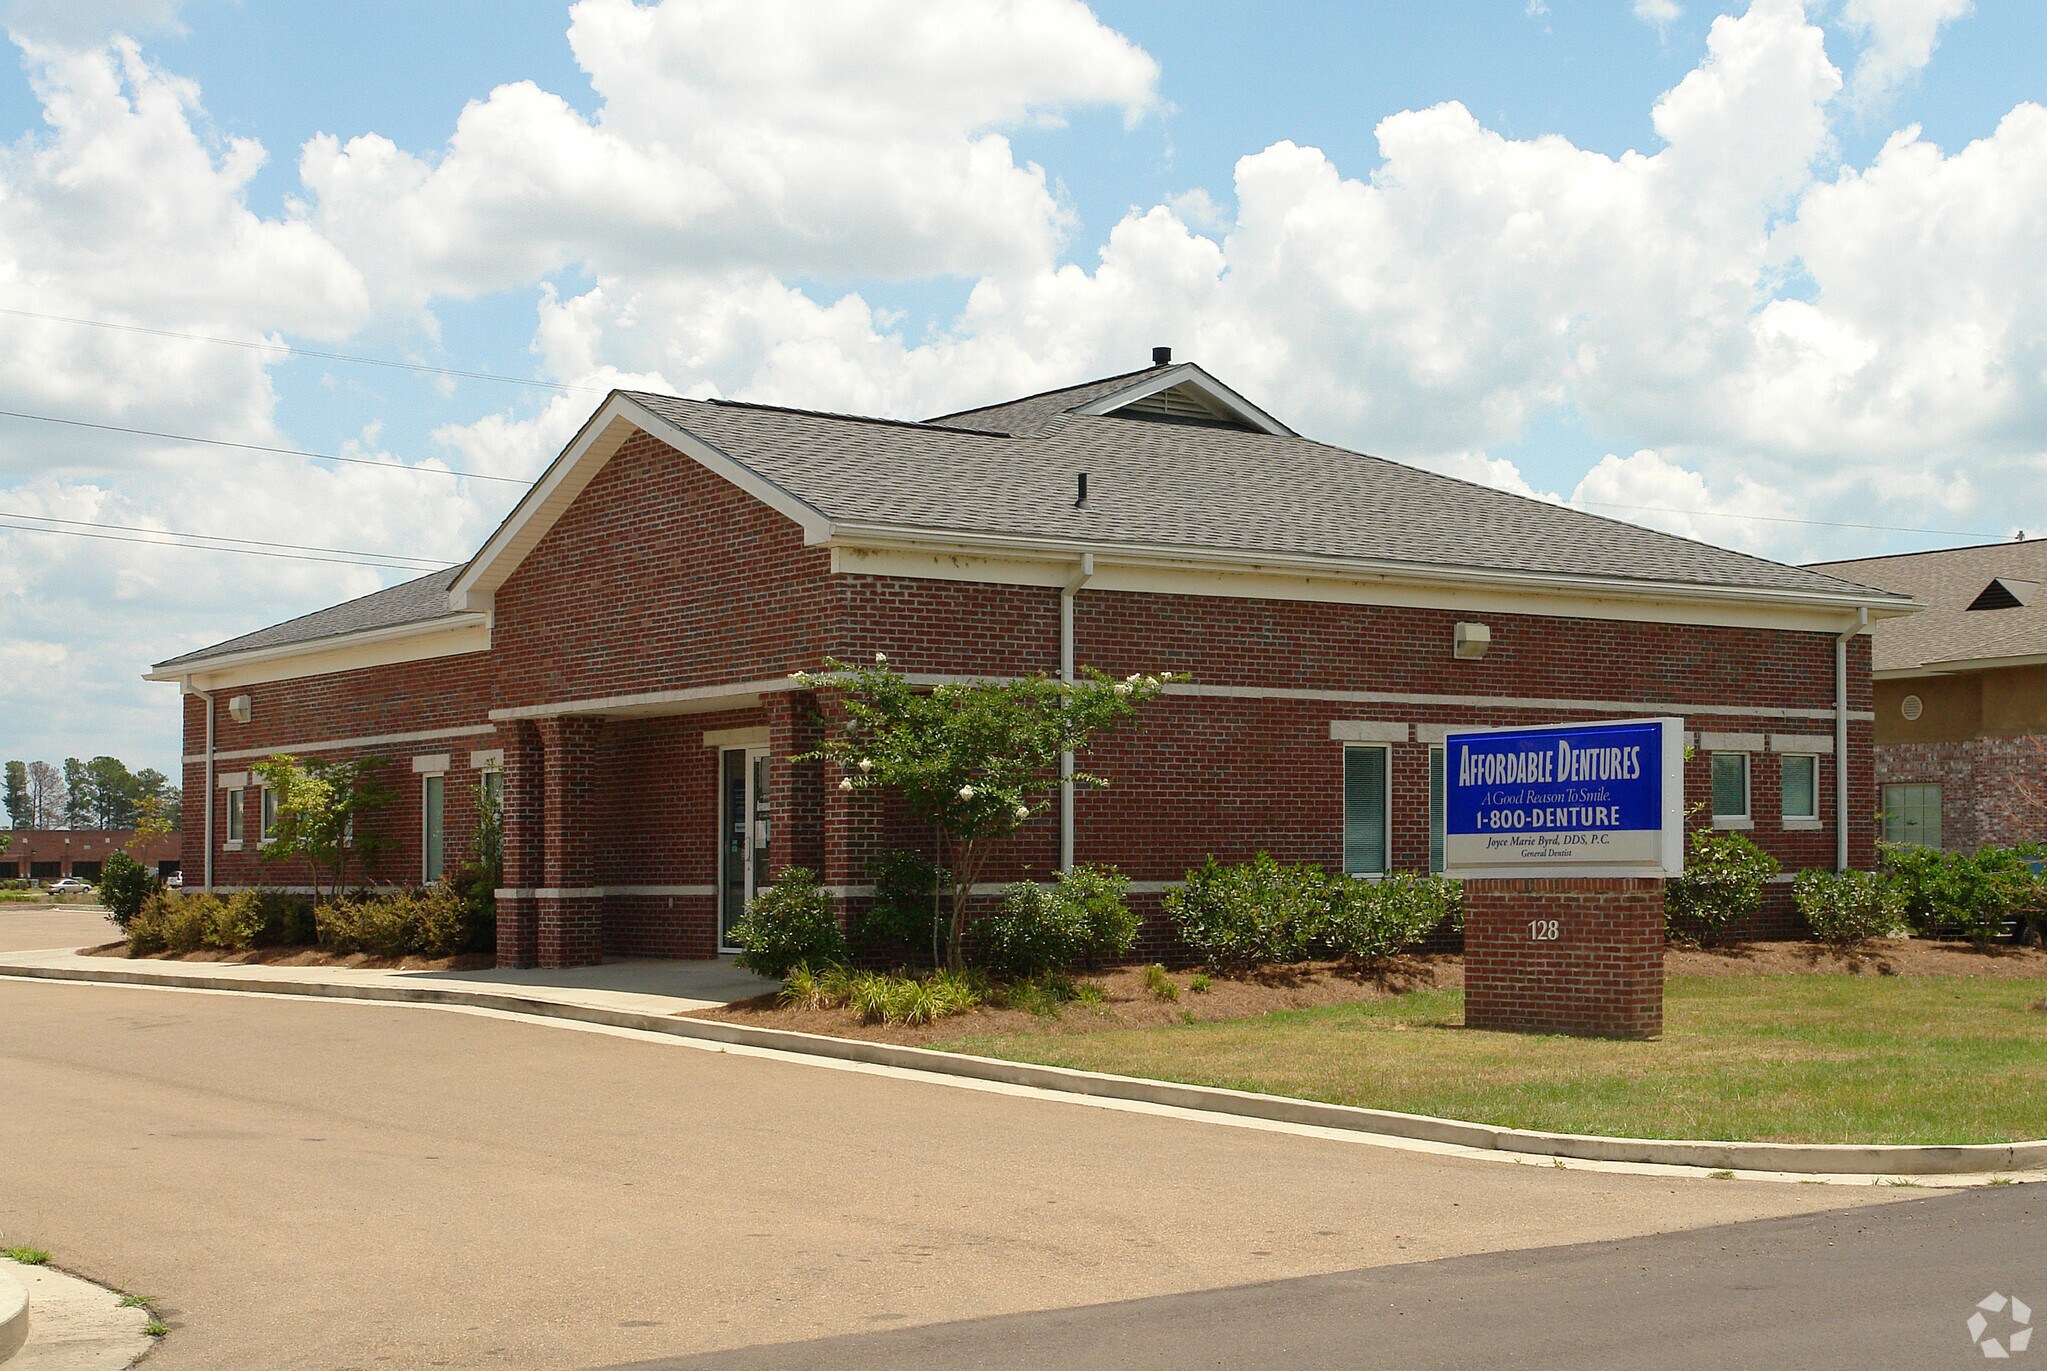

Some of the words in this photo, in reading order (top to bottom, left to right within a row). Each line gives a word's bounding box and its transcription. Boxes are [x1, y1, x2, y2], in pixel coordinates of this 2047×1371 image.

[1459, 745, 1553, 786] AFFORDABLE
[1557, 740, 1640, 782] DENTURES
[1482, 793, 1491, 805] A
[1491, 790, 1524, 805] Good
[1526, 790, 1564, 804] Reason
[1566, 789, 1579, 802] To
[1579, 787, 1611, 801] Smile.
[1476, 806, 1620, 828] 1-800-DENTURE
[1486, 837, 1508, 849] Joyce
[1510, 836, 1535, 846] Marie
[1538, 836, 1560, 848] Byrd,
[1563, 835, 1587, 845] DDS,
[1591, 834, 1610, 844] P.C.
[1521, 849, 1546, 858] General
[1548, 849, 1572, 857] Dentist
[1528, 920, 1559, 940] 128
